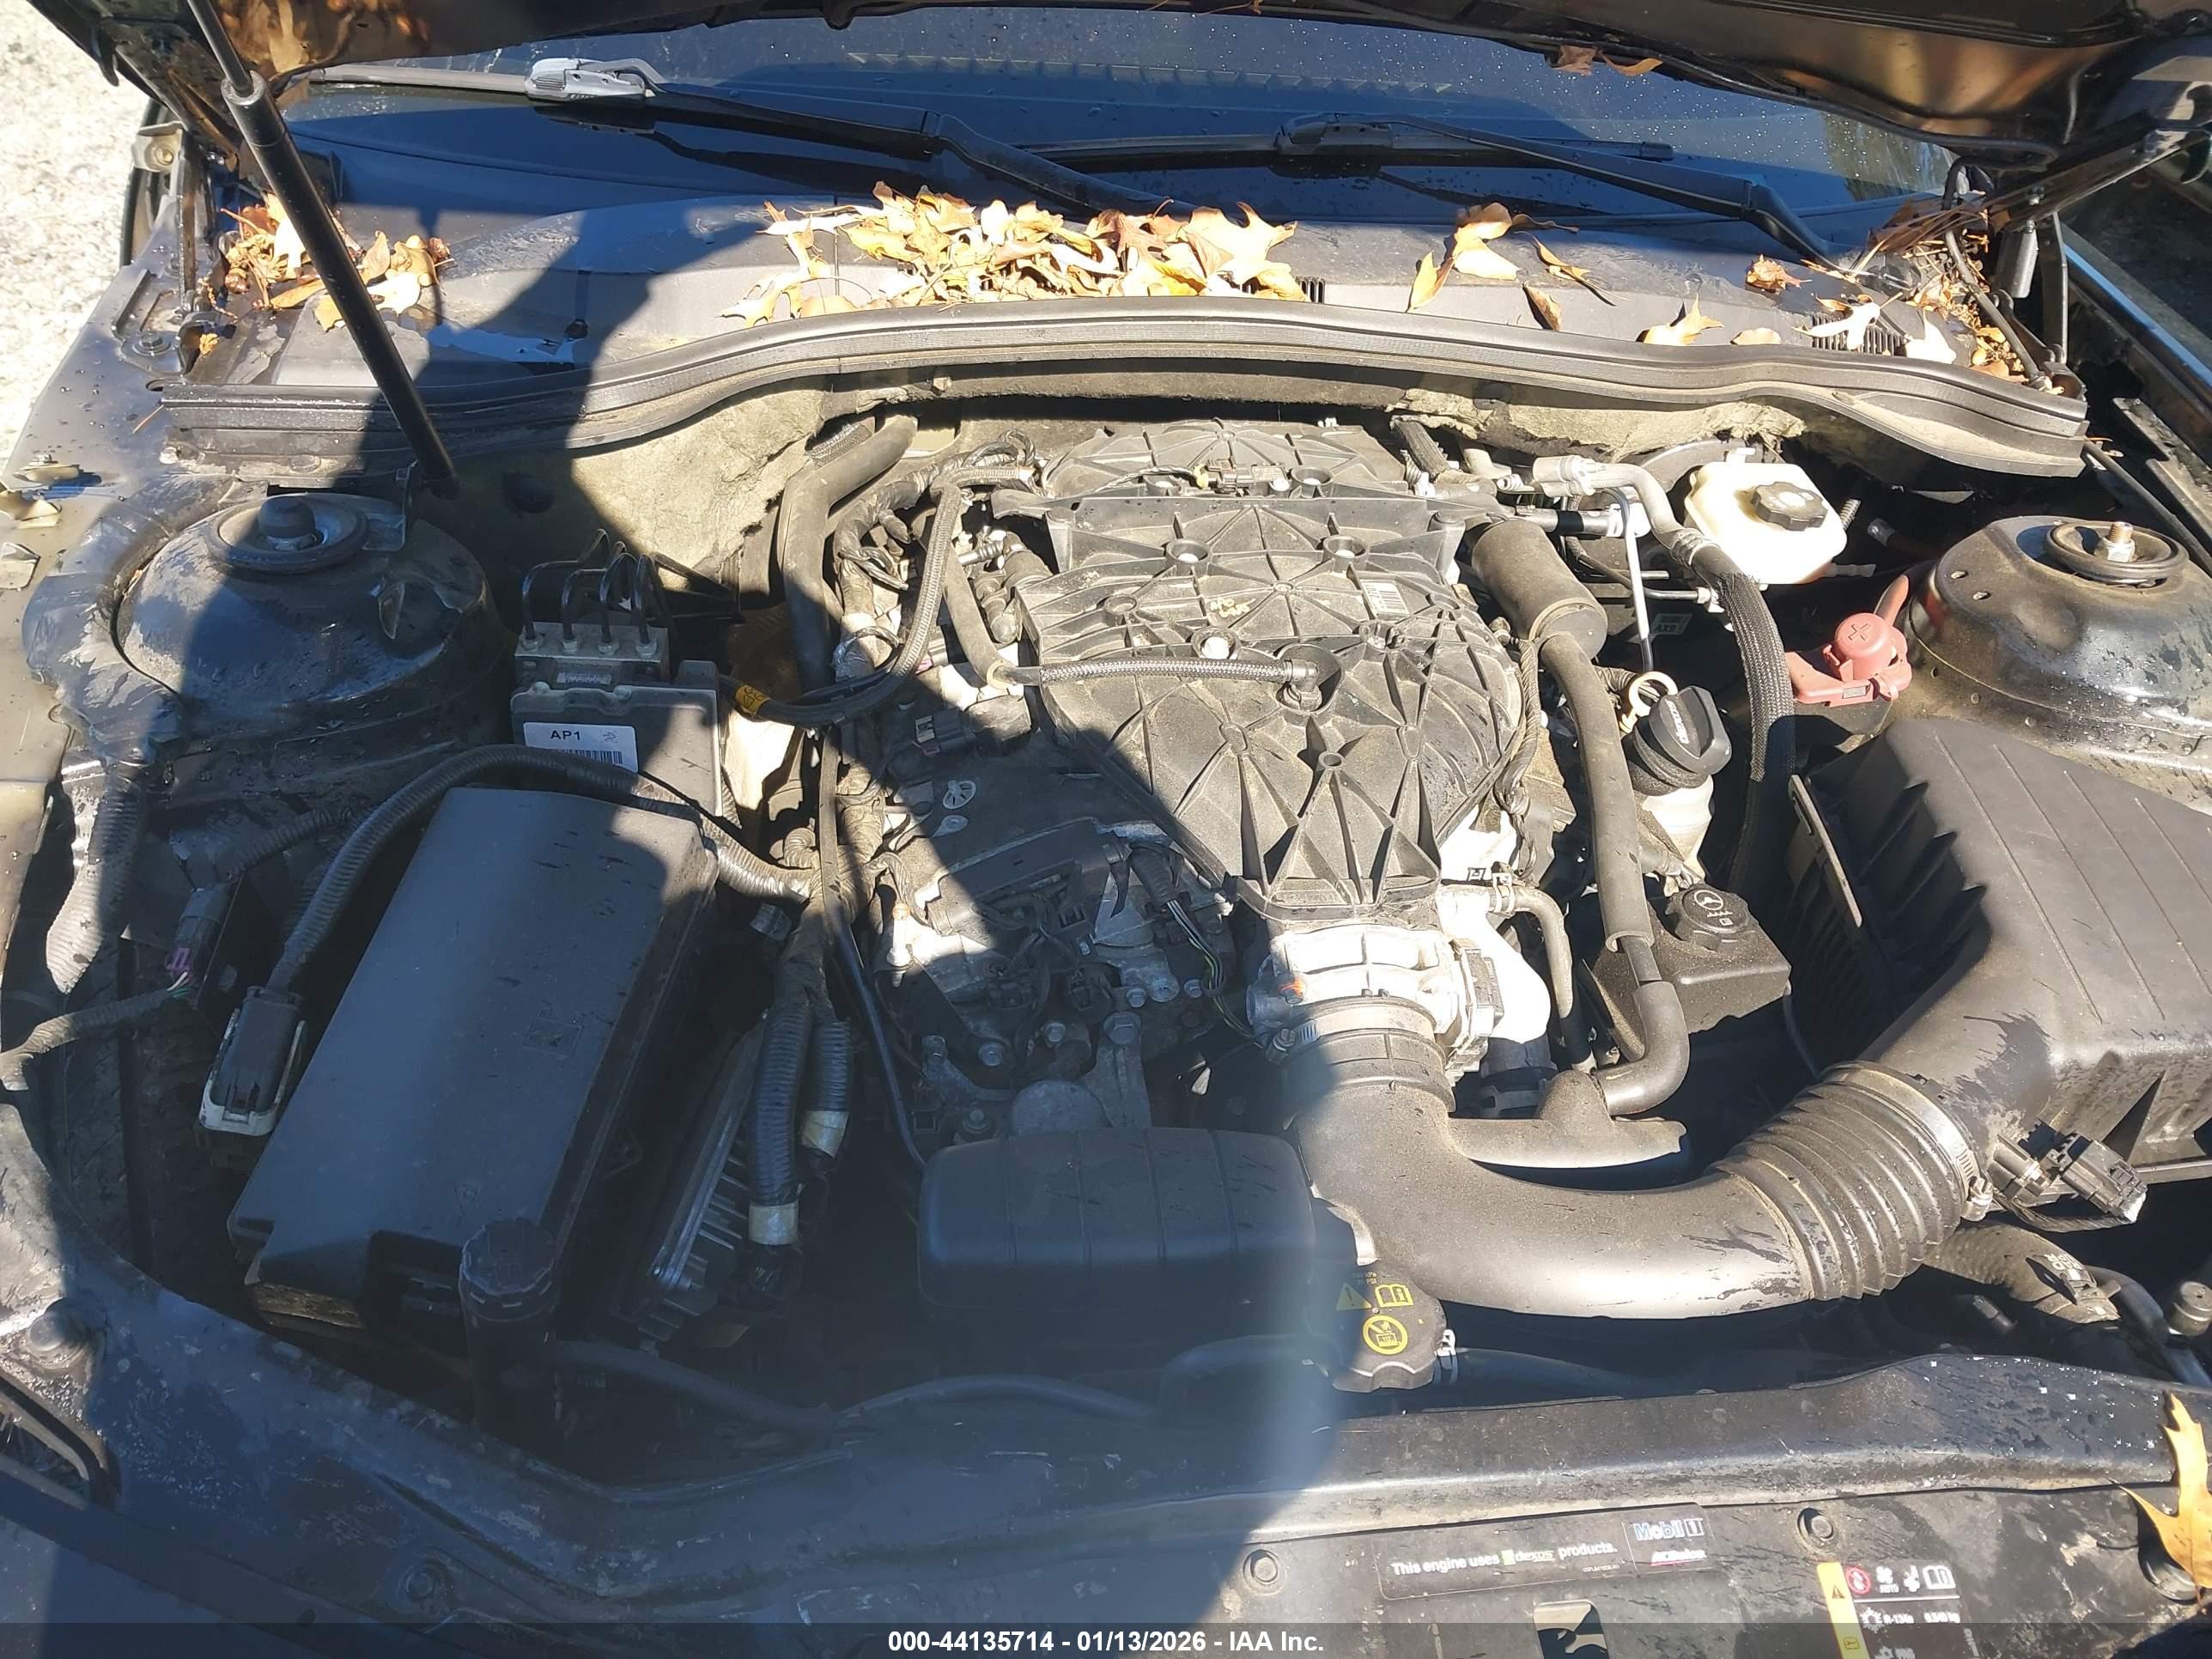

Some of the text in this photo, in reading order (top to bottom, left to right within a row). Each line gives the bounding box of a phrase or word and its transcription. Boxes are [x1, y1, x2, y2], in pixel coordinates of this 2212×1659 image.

[550, 730, 580, 740] AP1
[1633, 1520, 1685, 1540] Mobil
[1391, 1543, 1618, 1575] This engine uses dexos products.
